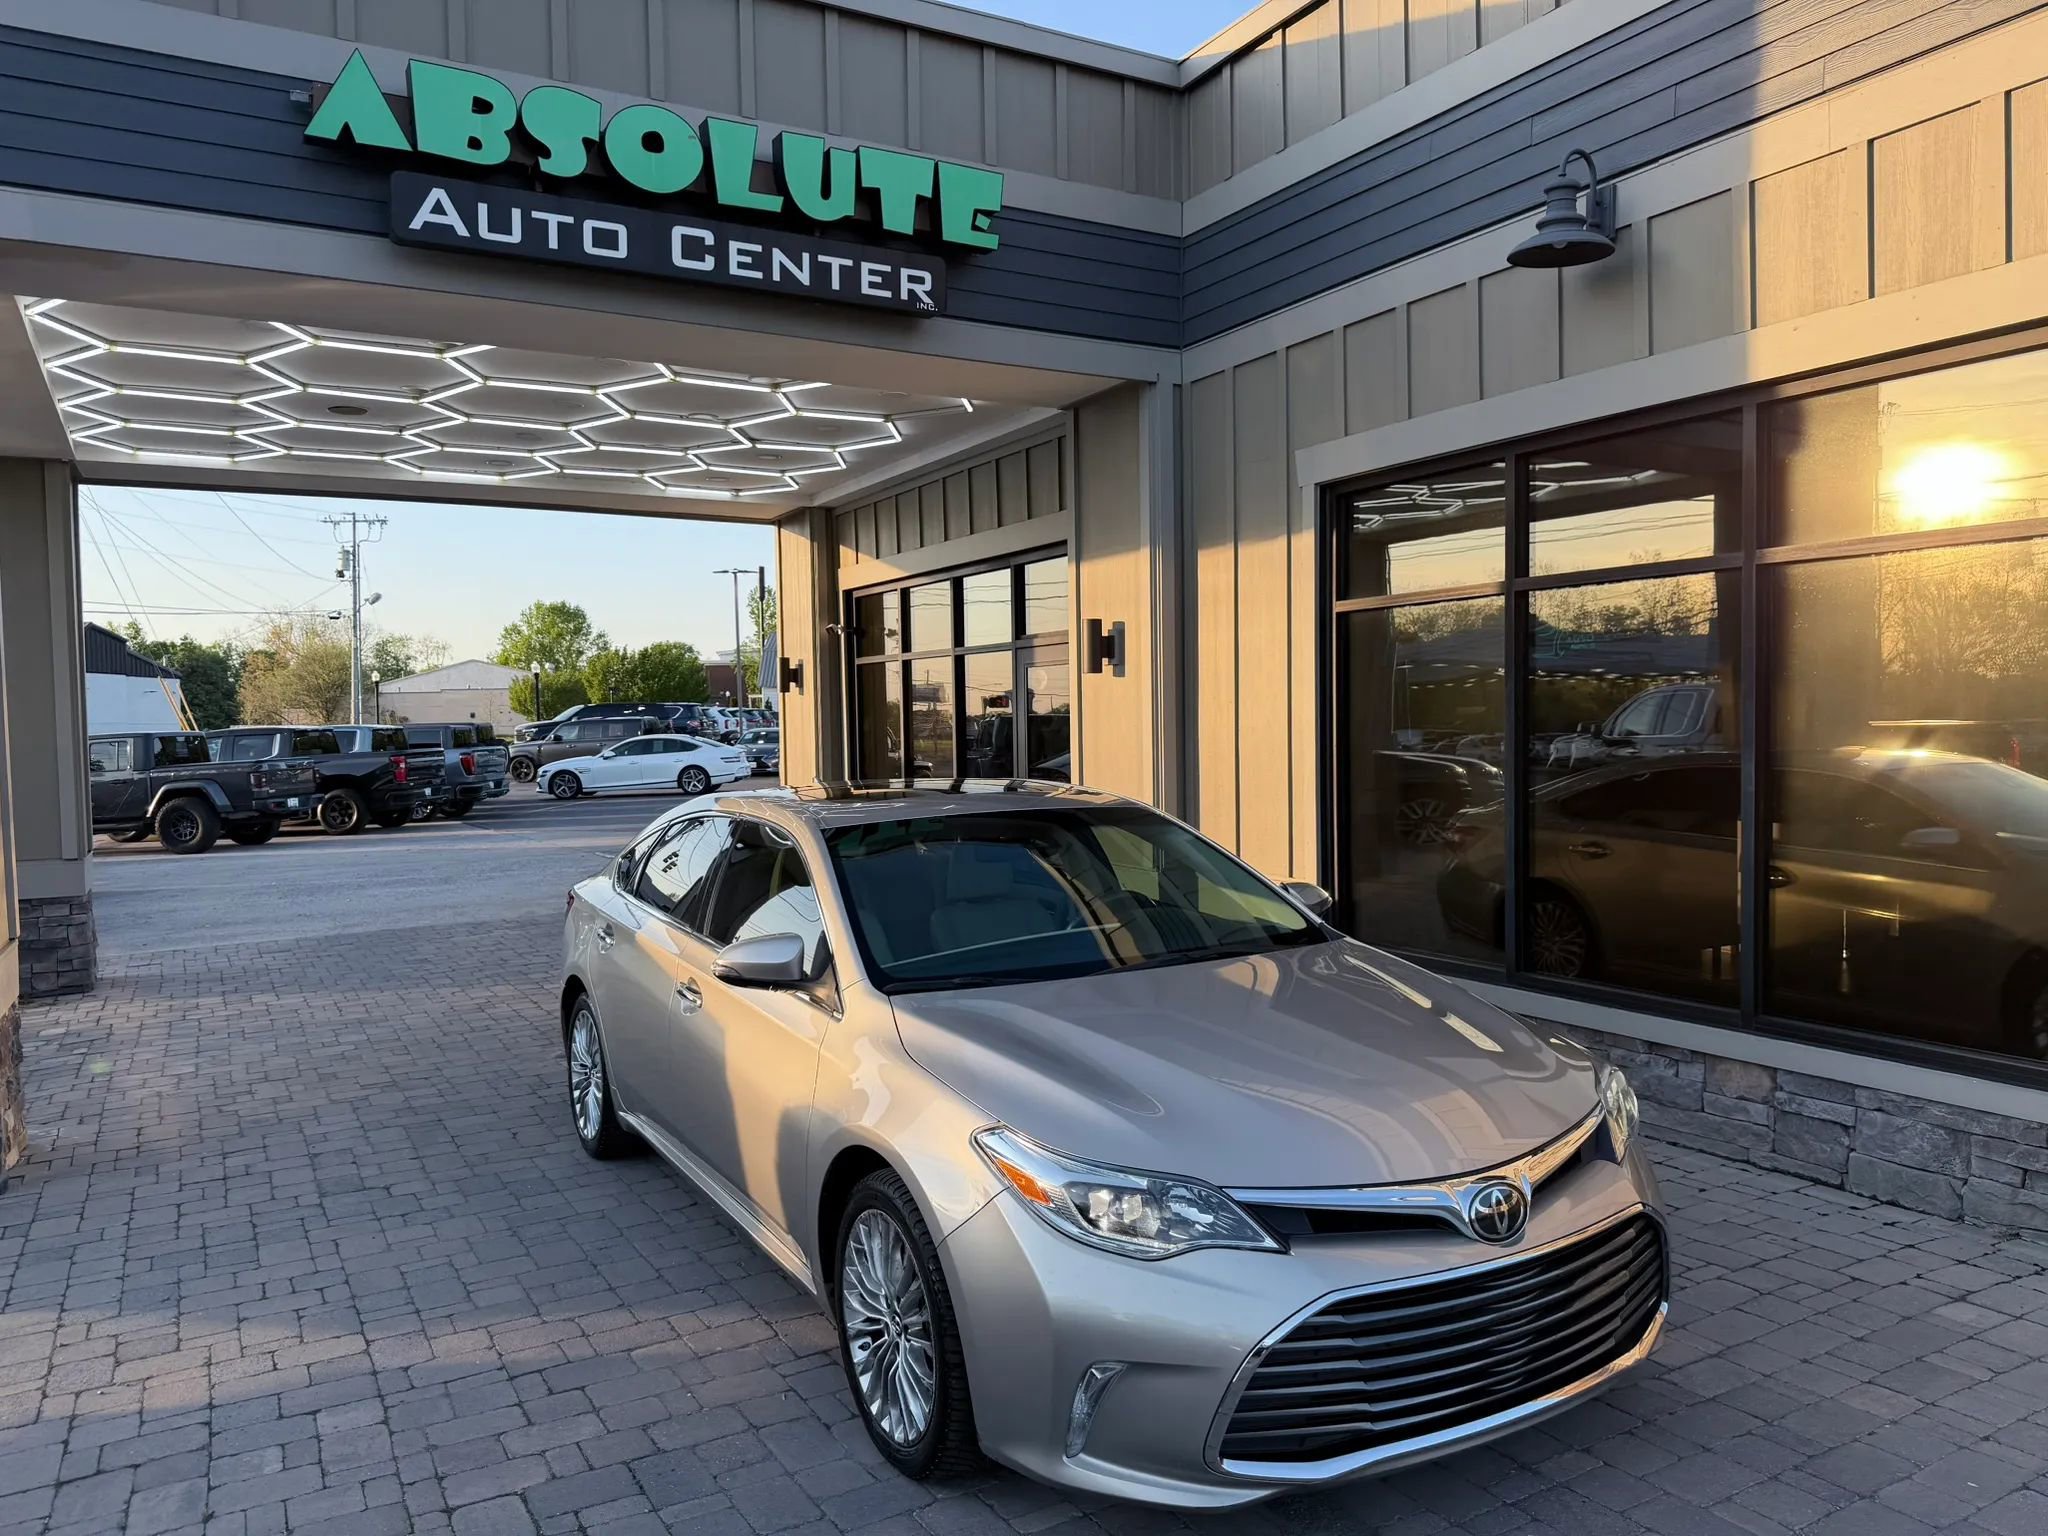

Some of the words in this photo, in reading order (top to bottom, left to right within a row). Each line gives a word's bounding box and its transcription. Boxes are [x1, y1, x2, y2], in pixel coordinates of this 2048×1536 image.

[303, 47, 1004, 251] ABSOLUTE
[408, 187, 628, 259] AUTO
[671, 225, 934, 304] CENTER
[916, 302, 938, 311] INC.
